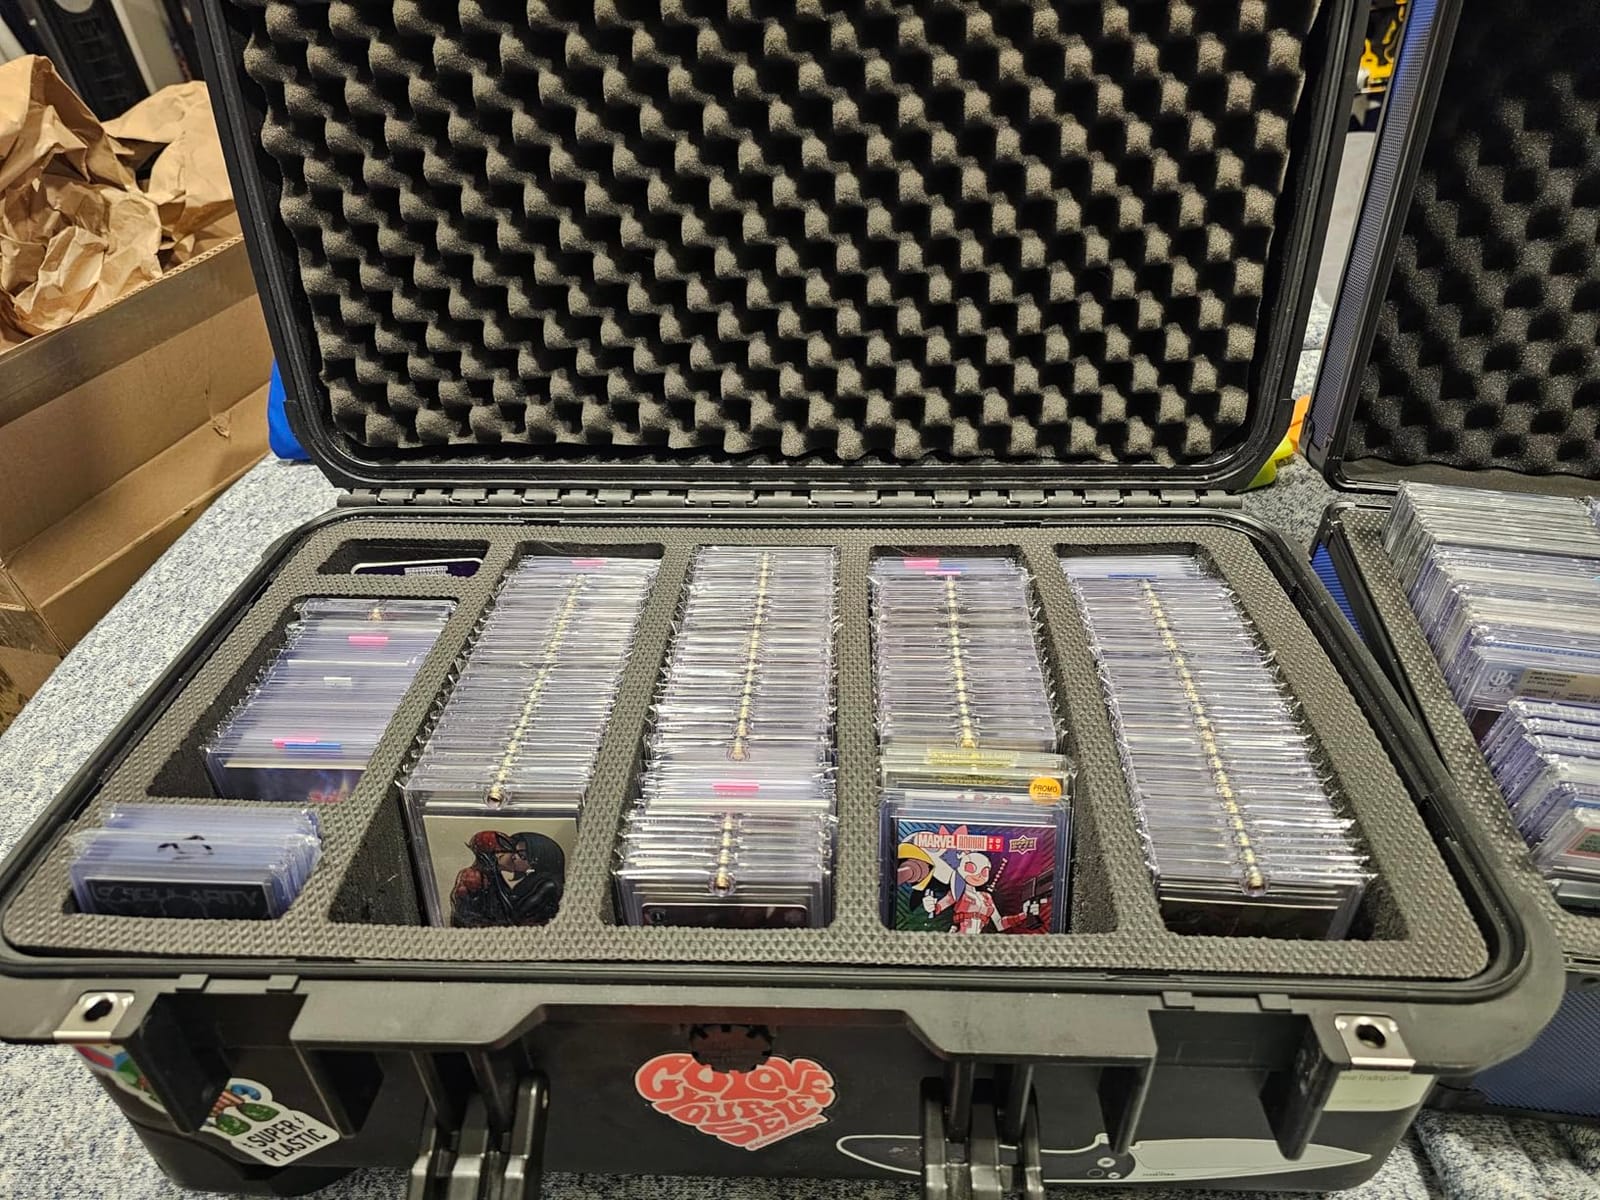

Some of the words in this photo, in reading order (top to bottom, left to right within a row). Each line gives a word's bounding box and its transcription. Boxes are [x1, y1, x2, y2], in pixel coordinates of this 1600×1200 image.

[1033, 784, 1058, 793] PROMO
[915, 834, 956, 848] MARVEL
[639, 1054, 729, 1100] GO
[721, 1058, 834, 1107] LOVE
[246, 1120, 302, 1147] SUPER
[262, 1129, 328, 1162] PLASTIC
